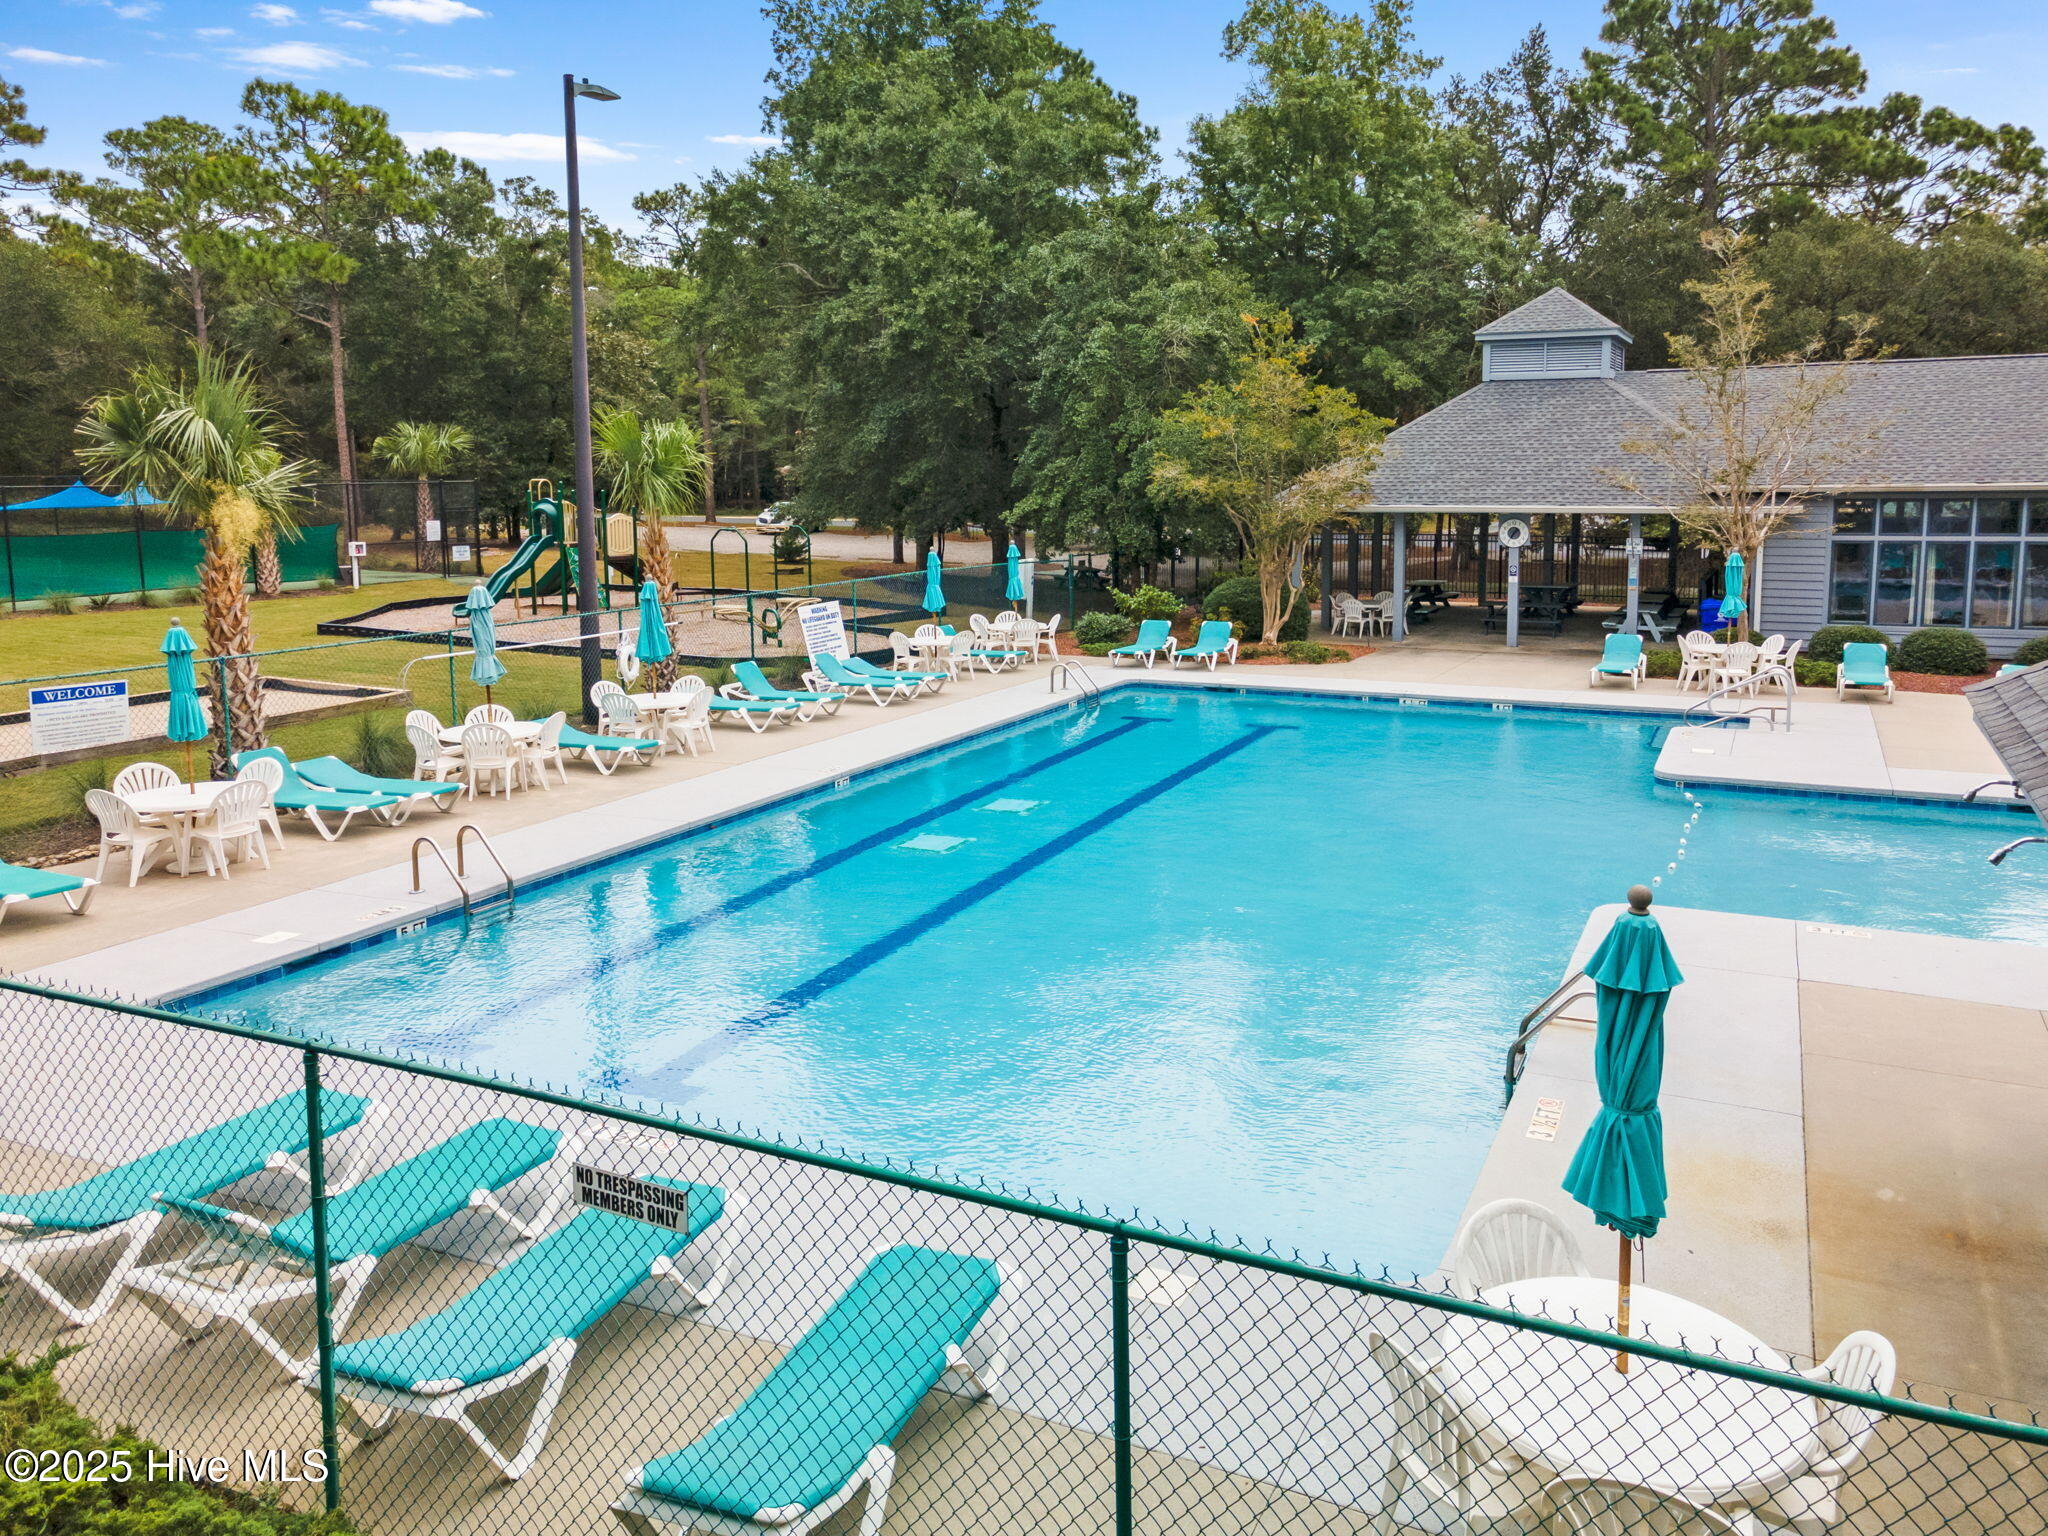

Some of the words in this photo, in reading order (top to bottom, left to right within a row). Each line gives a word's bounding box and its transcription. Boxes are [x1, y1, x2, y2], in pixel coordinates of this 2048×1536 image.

[43, 685, 117, 701] WELCOME
[576, 1166, 593, 1186] NO
[596, 1172, 684, 1211] TRESPASSING
[582, 1186, 644, 1220] MEMBERS
[647, 1204, 678, 1228] ONLY
